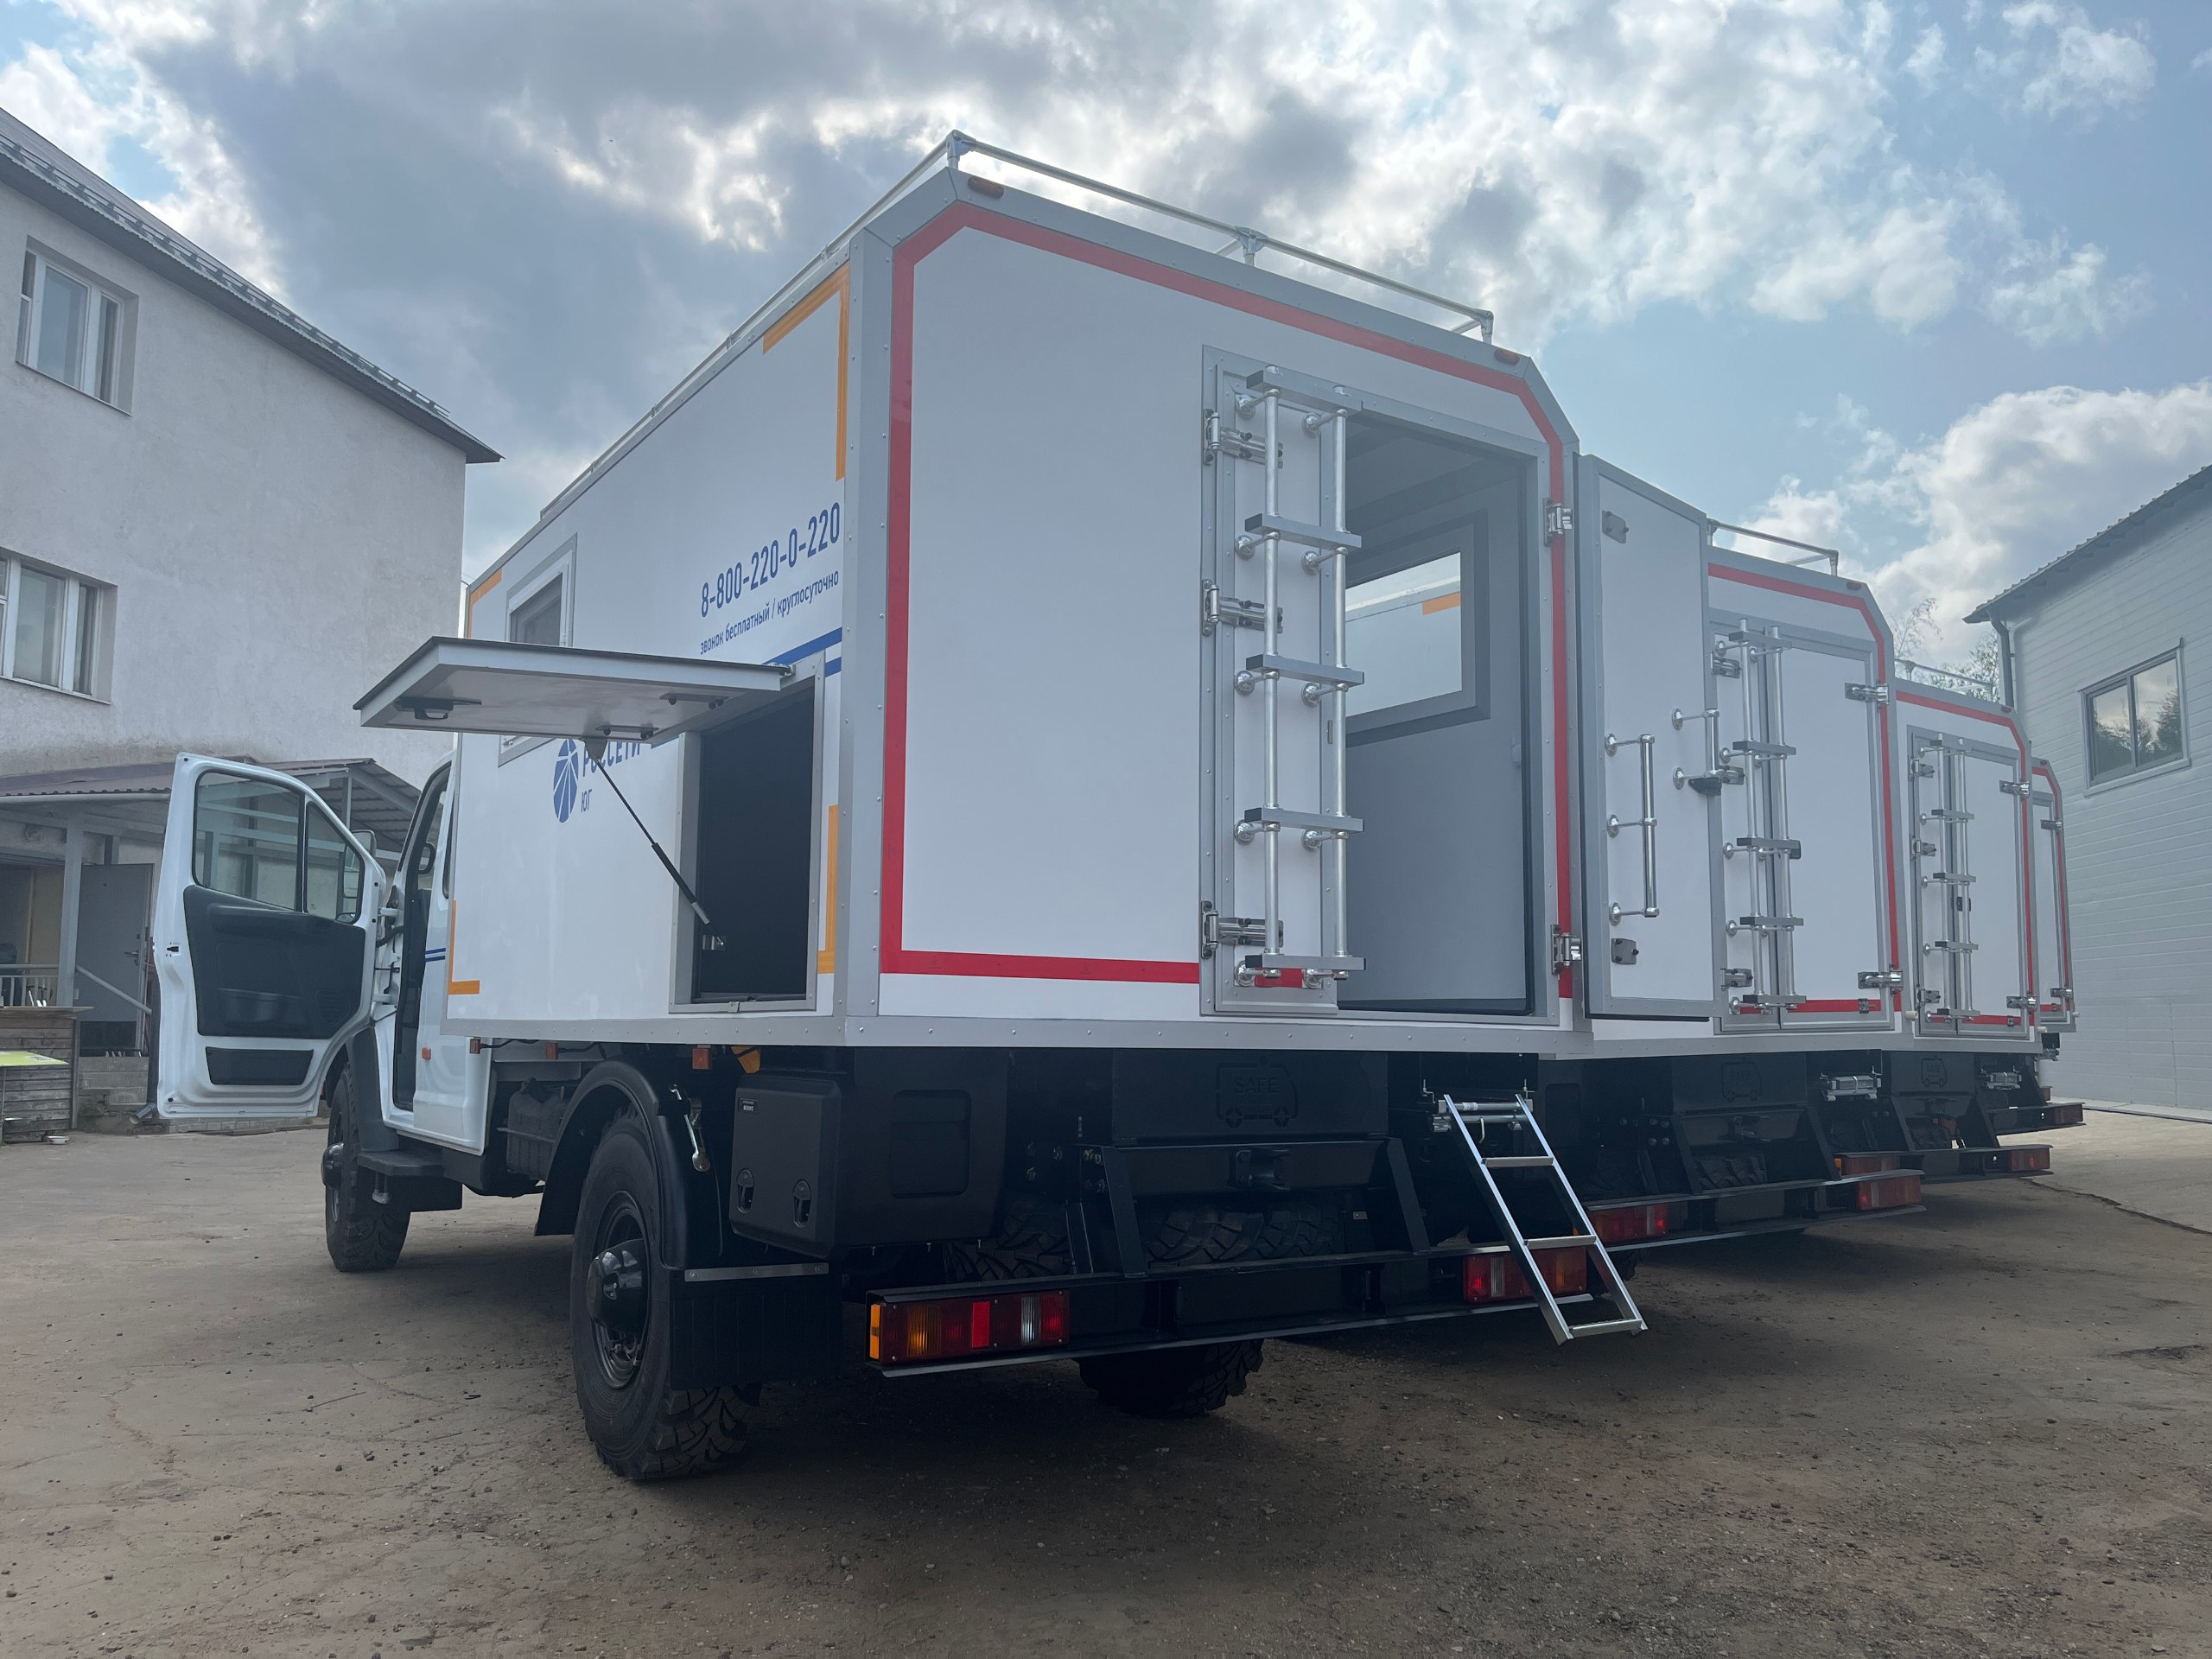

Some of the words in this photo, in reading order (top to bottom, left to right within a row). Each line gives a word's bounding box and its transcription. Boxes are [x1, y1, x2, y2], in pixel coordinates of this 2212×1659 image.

[701, 502, 841, 618] 8-800-220-0-220
[700, 632, 724, 655] звонок
[725, 602, 770, 642] бесплатный
[777, 570, 839, 618] круглосуточно
[581, 789, 593, 812] ЮГ
[1234, 1077, 1279, 1094] SAFE
